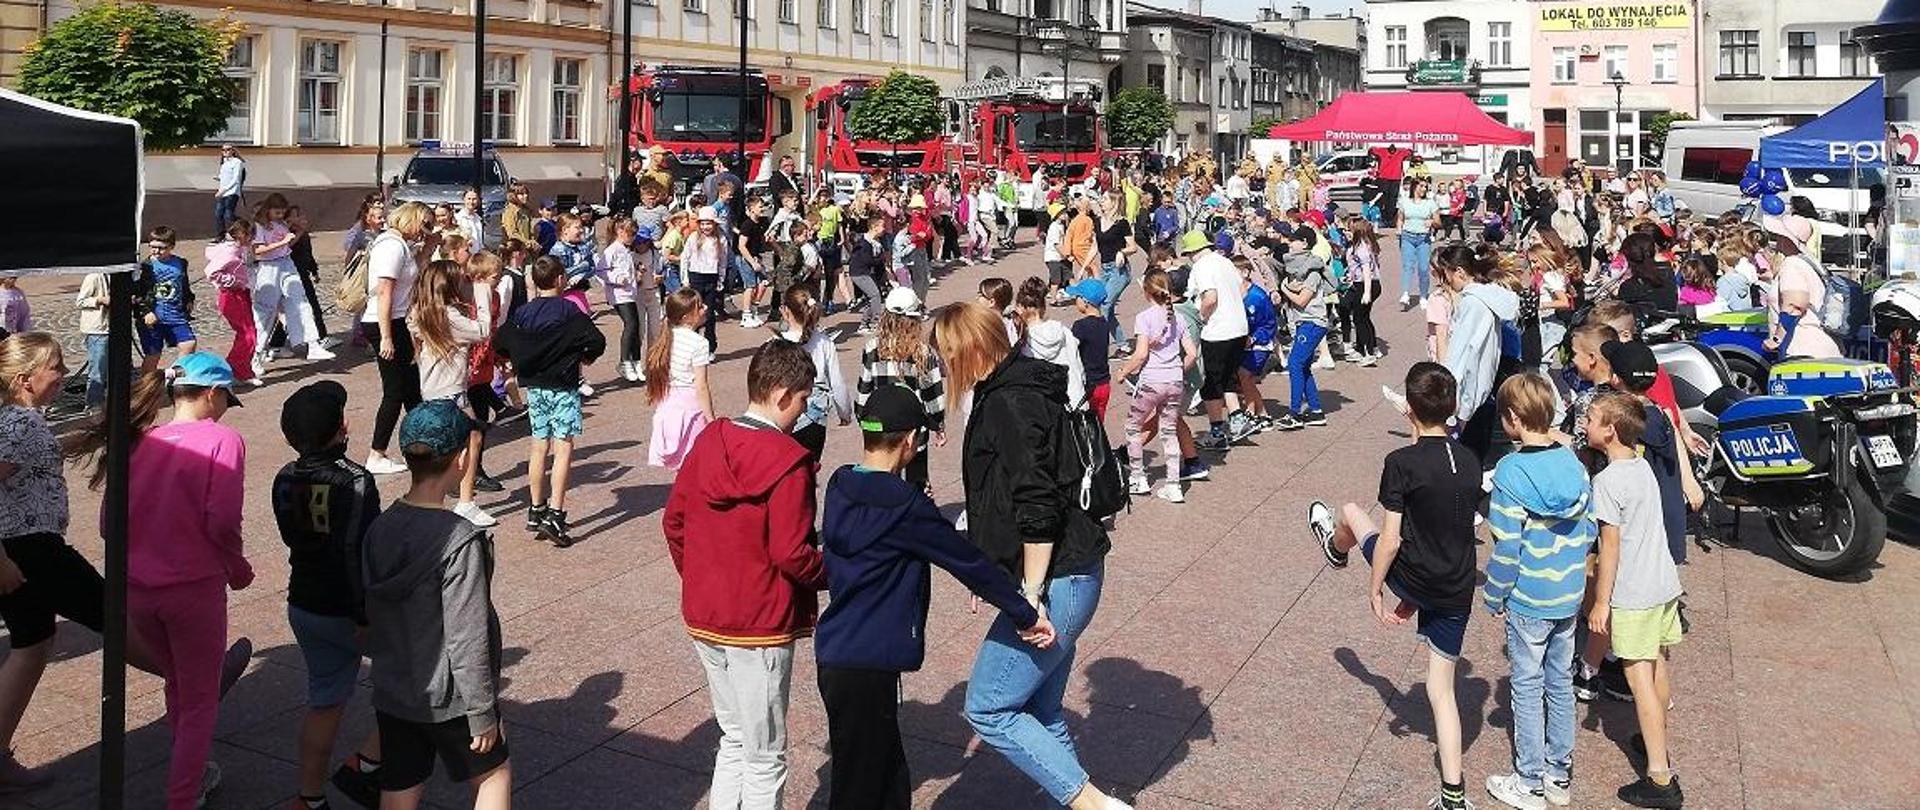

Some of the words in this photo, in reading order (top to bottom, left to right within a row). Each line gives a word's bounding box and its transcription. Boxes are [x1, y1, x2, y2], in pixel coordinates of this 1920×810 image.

[1542, 8, 1584, 20] LOKAL
[1587, 7, 1605, 19] DO
[1609, 4, 1687, 20] WYNAJĘCIA
[1570, 19, 1589, 29] Tel.
[1615, 18, 1634, 28] 789
[1325, 130, 1383, 140] Państwowa
[1415, 132, 1459, 141] Pożarna
[1730, 434, 1796, 459] POLICJA
